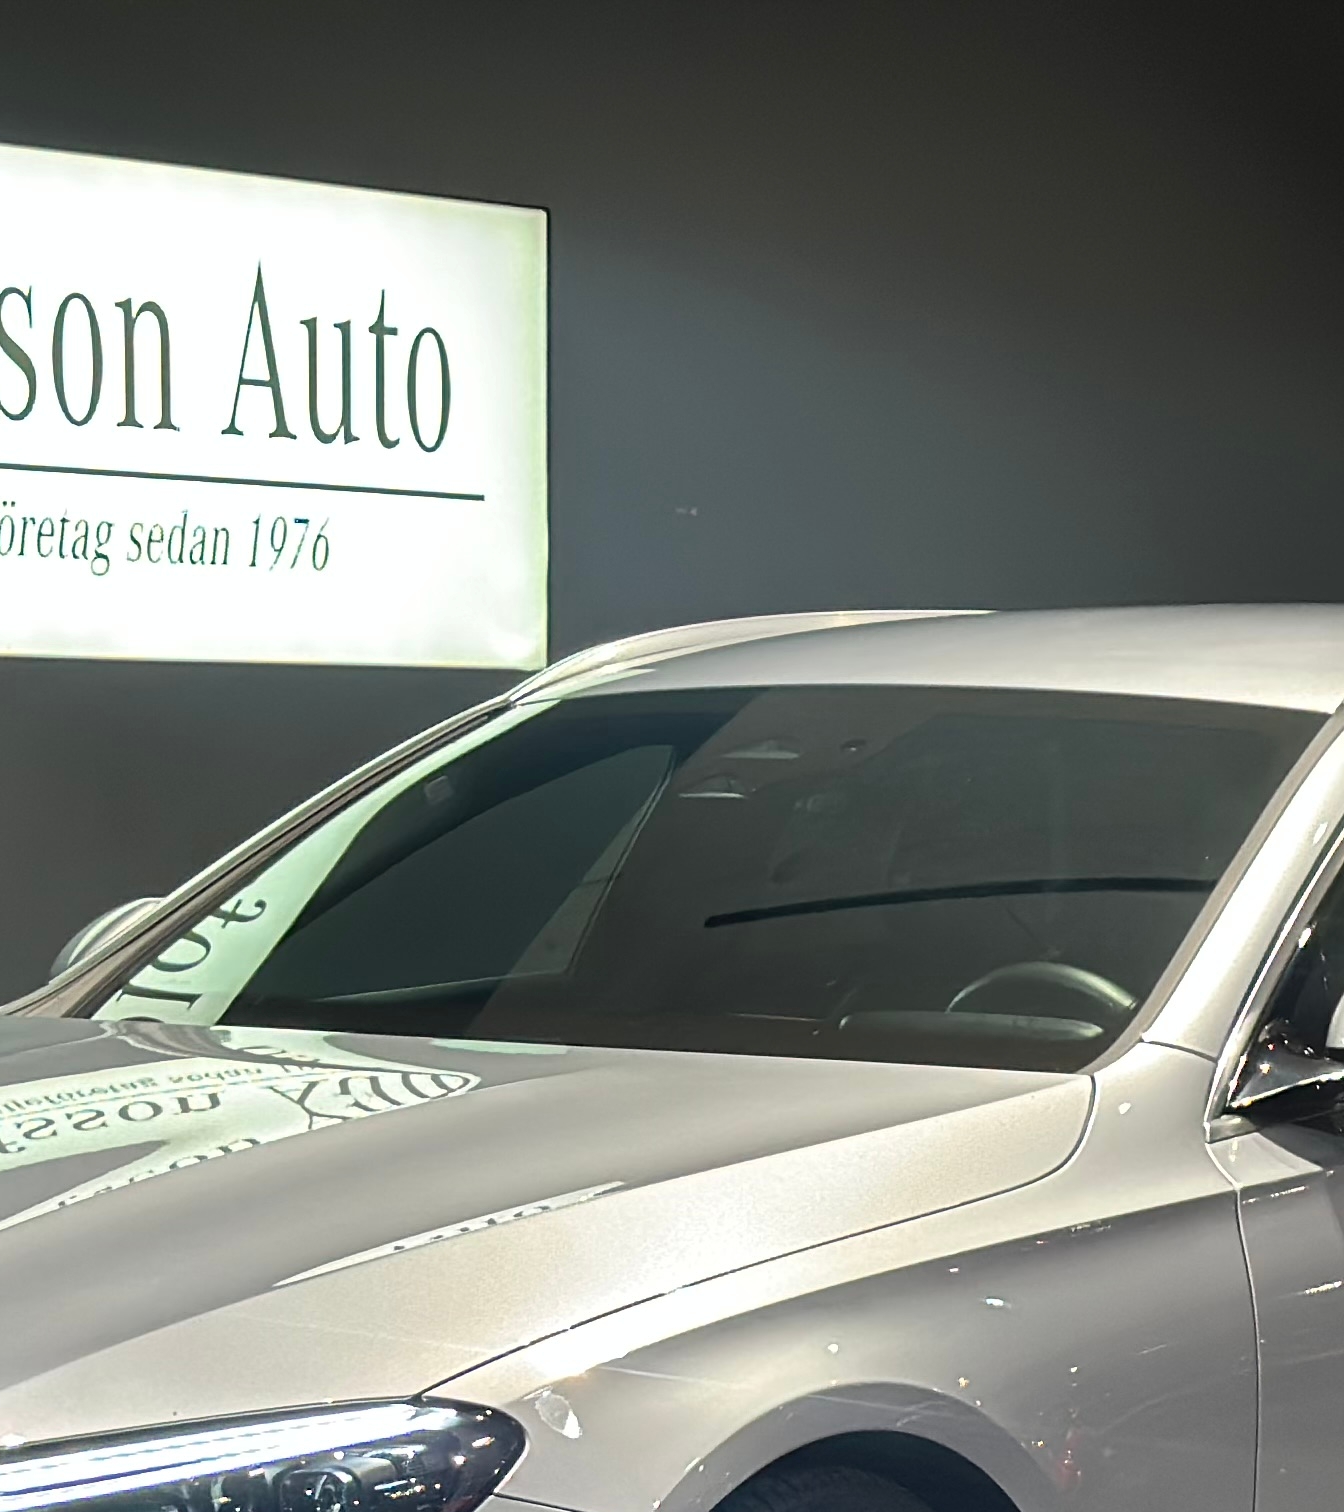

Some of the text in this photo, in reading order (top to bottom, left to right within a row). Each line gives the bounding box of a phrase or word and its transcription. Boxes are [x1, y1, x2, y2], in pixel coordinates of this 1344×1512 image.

[220, 259, 452, 454] Auto
[126, 508, 230, 568] sedan
[248, 513, 332, 573] 1976
